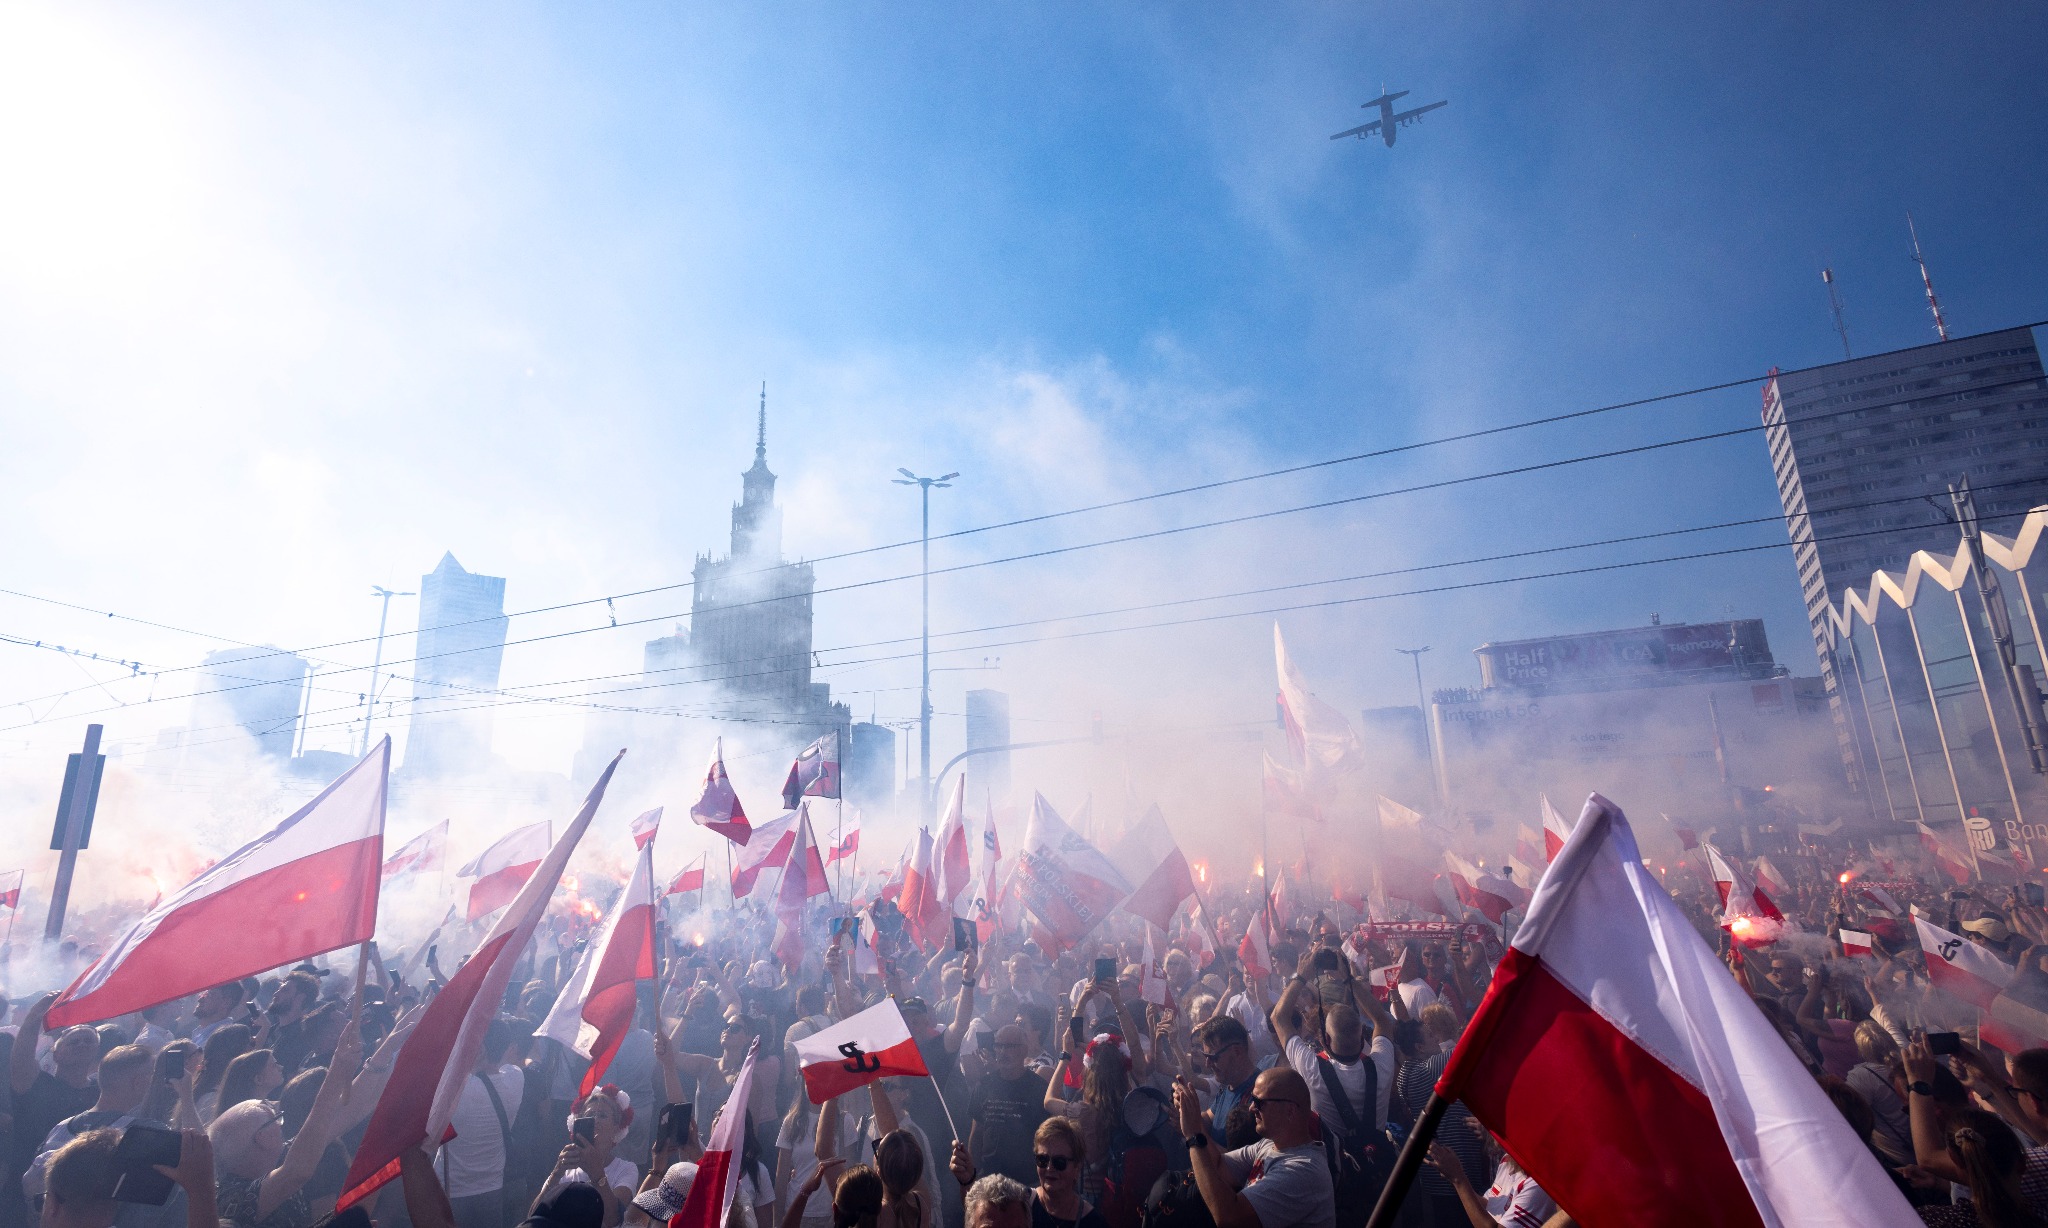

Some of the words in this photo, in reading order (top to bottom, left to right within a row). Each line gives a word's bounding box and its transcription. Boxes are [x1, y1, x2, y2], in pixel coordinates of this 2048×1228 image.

[1504, 648, 1546, 666] Half
[1507, 663, 1549, 680] Price
[1442, 705, 1511, 722] Internet
[1516, 703, 1541, 717] 5G
[1569, 733, 1579, 743] A
[1580, 732, 1596, 743] do
[1598, 731, 1626, 743] tego
[1036, 864, 1095, 923] POLSKIEJ
[1373, 922, 1479, 936] POLSKA
